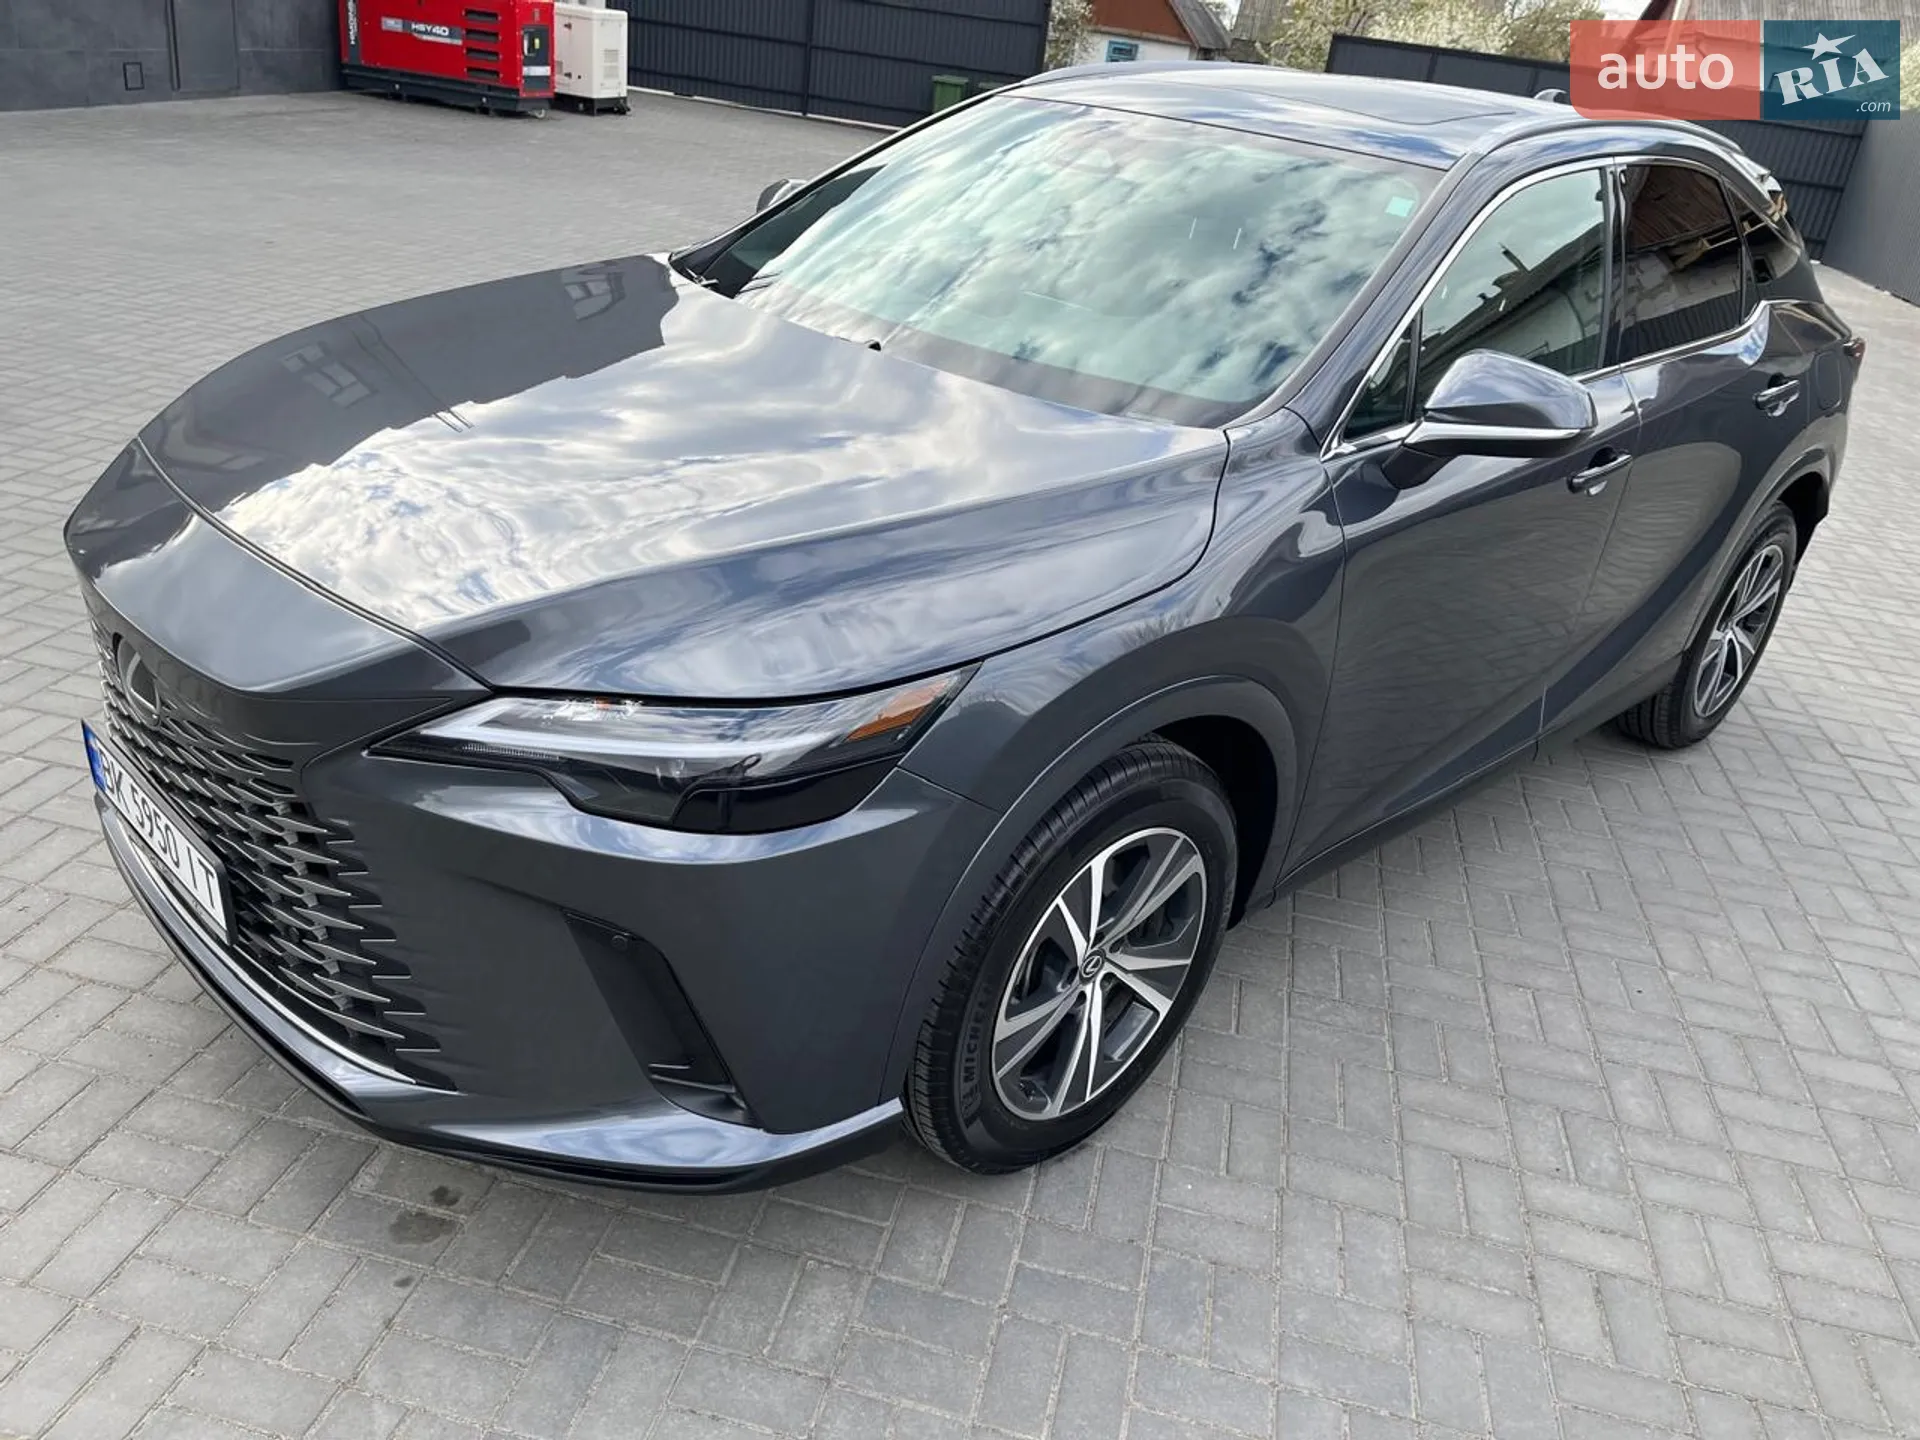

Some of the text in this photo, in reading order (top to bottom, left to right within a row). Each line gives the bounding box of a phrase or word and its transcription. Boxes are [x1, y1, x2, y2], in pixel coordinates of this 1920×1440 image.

[131, 784, 181, 869] 5950
[187, 846, 216, 909] IT
[962, 978, 993, 1084] MICH
